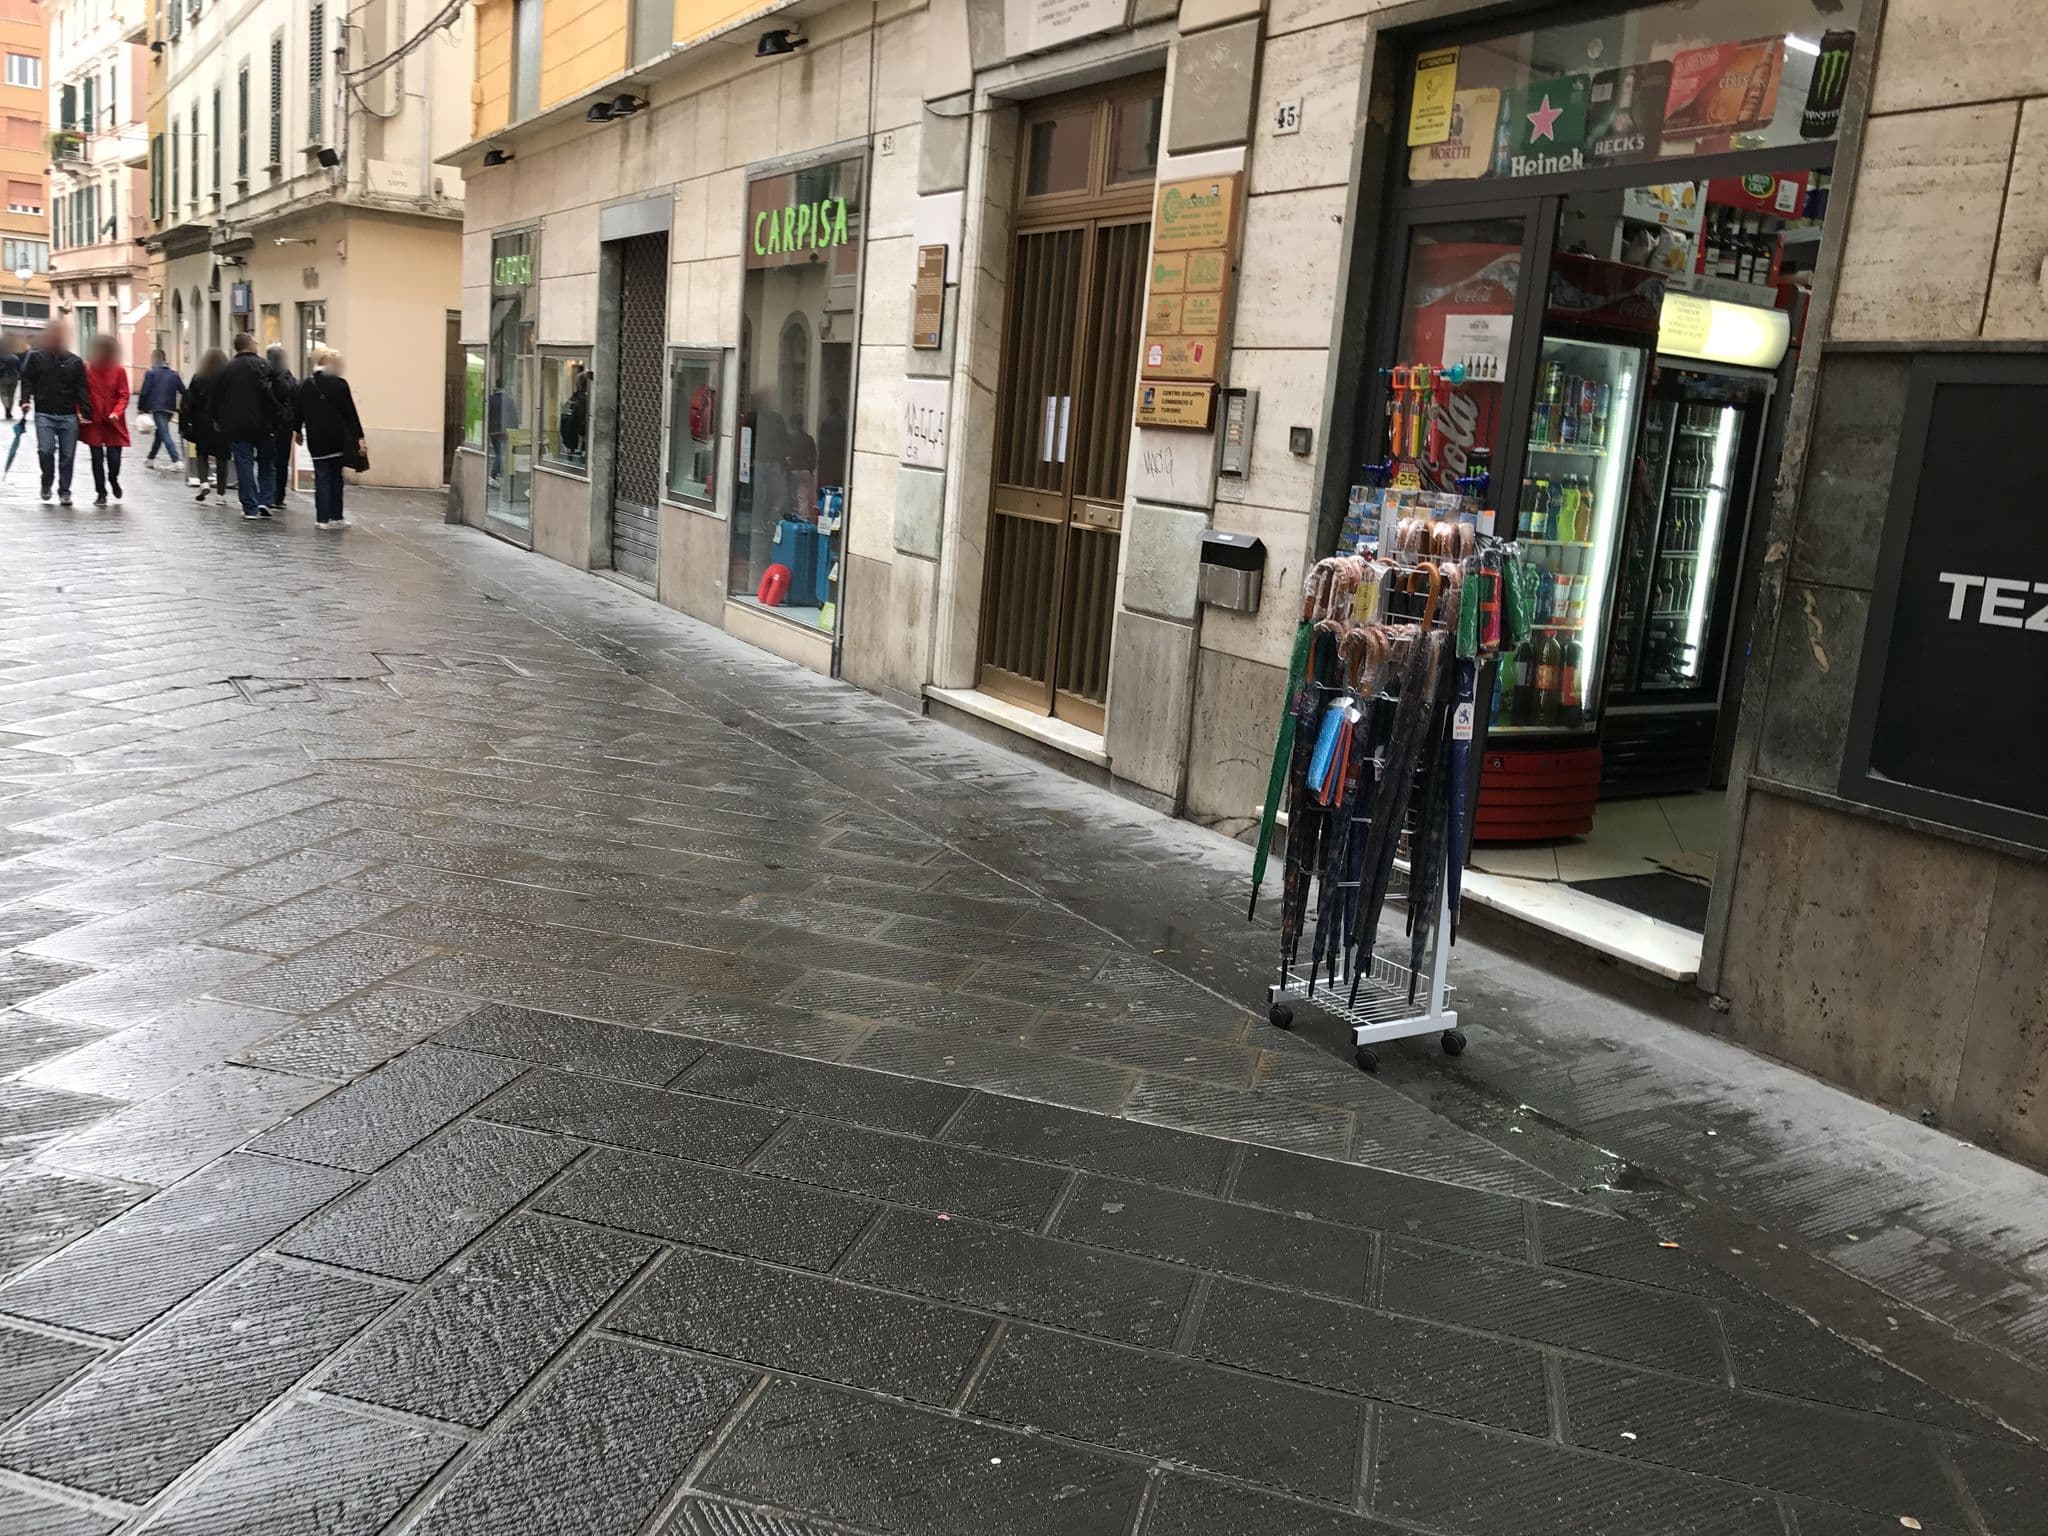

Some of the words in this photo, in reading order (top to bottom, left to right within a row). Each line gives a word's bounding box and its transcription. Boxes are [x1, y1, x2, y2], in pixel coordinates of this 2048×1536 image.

[1277, 105, 1296, 129] 45
[1594, 133, 1646, 156] BECK'S
[754, 197, 848, 256] CARPISA
[1938, 571, 2048, 633] TEZ
